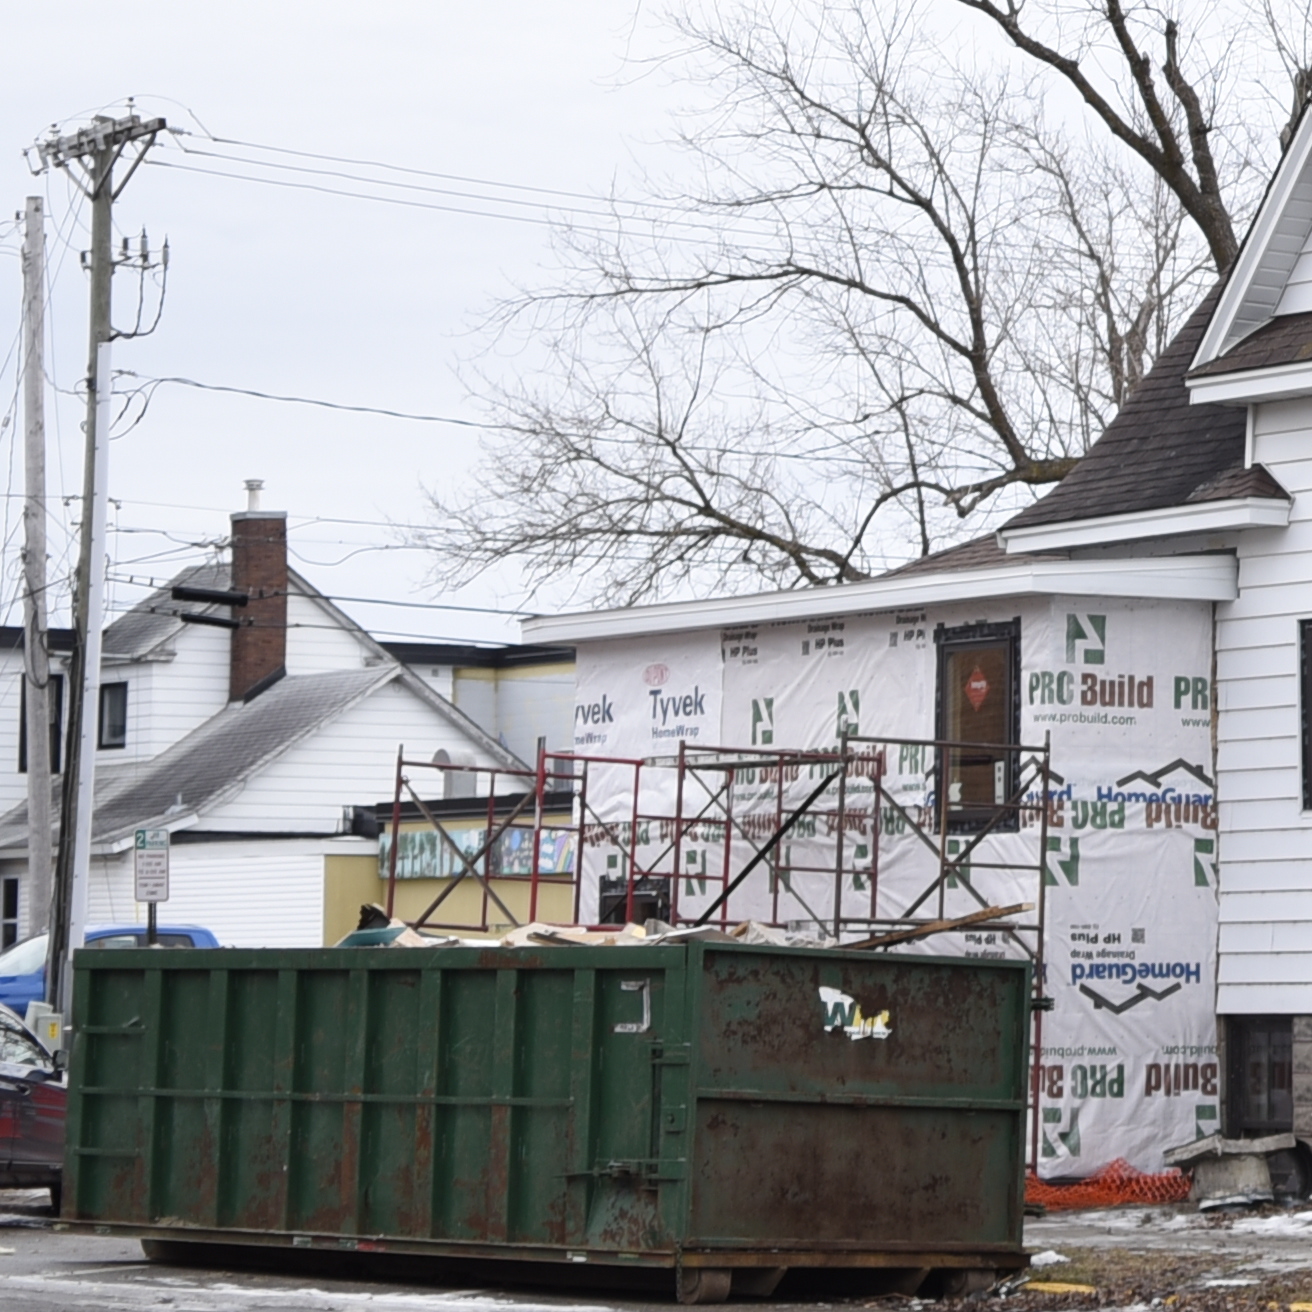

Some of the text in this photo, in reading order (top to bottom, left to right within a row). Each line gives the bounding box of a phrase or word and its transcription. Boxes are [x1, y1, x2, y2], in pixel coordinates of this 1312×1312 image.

[1080, 673, 1154, 708] Build
[649, 686, 706, 726] Tyvek
[651, 725, 700, 739] HomeWrap
[136, 832, 145, 847] 2
[1070, 932, 1121, 945] HP Plus
[1070, 948, 1136, 960] Drainage Wrap
[1071, 962, 1201, 986] HomeGuard
[1145, 1063, 1218, 1098] Build
